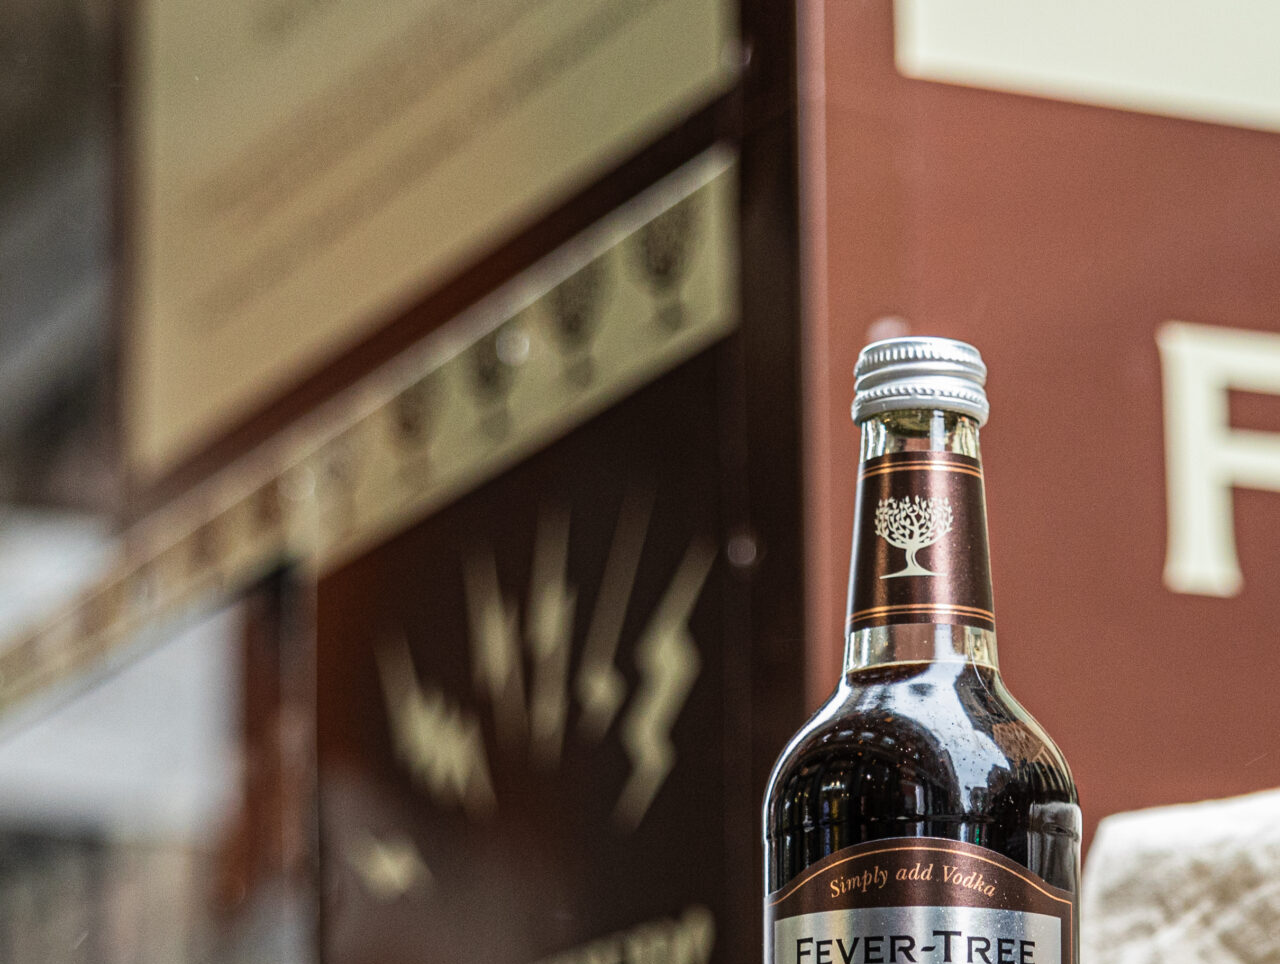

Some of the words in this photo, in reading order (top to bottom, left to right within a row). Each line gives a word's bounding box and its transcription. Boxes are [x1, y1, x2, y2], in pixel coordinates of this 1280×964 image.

[830, 866, 889, 899] Simply
[896, 863, 933, 881] add
[942, 865, 997, 897] Vodka
